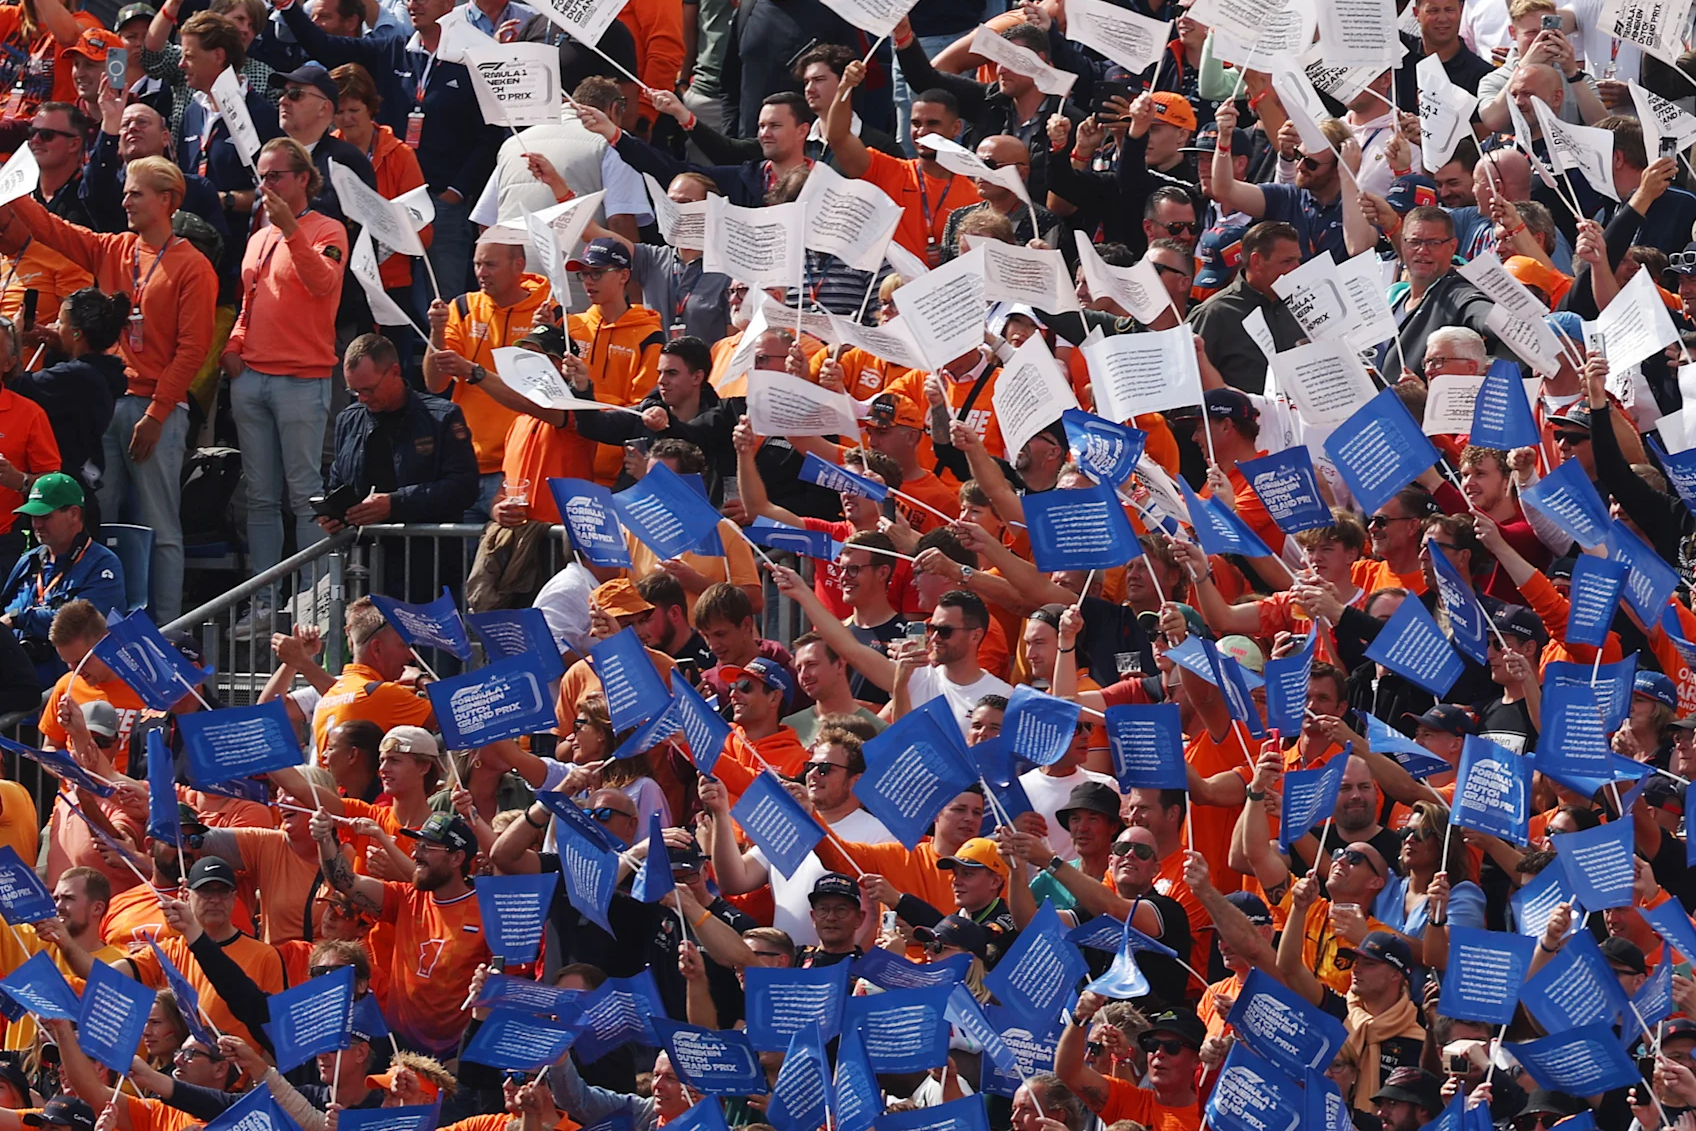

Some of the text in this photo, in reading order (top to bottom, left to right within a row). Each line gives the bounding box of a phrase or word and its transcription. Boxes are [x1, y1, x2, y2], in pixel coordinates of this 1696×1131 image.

[508, 92, 531, 100] PRIX
[1255, 475, 1296, 493] FORMULA
[1259, 482, 1301, 499] HEINEKEN
[1264, 490, 1292, 506] DUTCH
[1268, 495, 1313, 513] GRAND PRIX
[449, 684, 504, 708] FORMULA
[452, 692, 506, 716] HEINEKEN
[454, 704, 491, 721] DUTCH
[456, 701, 521, 730] GRAND PRIX
[1466, 783, 1500, 799] DUTCH
[1463, 790, 1516, 814] GRAND PRIX
[1247, 1005, 1278, 1032] DUTCH
[1249, 1000, 1297, 1037] HEINEKEN
[1253, 994, 1299, 1033] FORMULA
[1244, 1010, 1300, 1056] GRAND PRIX
[672, 1040, 721, 1050] FORMULA
[674, 1047, 722, 1057] HEINEKEN
[677, 1054, 708, 1064] DUTCH
[713, 1063, 738, 1072] PRIX
[1241, 1111, 1267, 1131] PRIX
